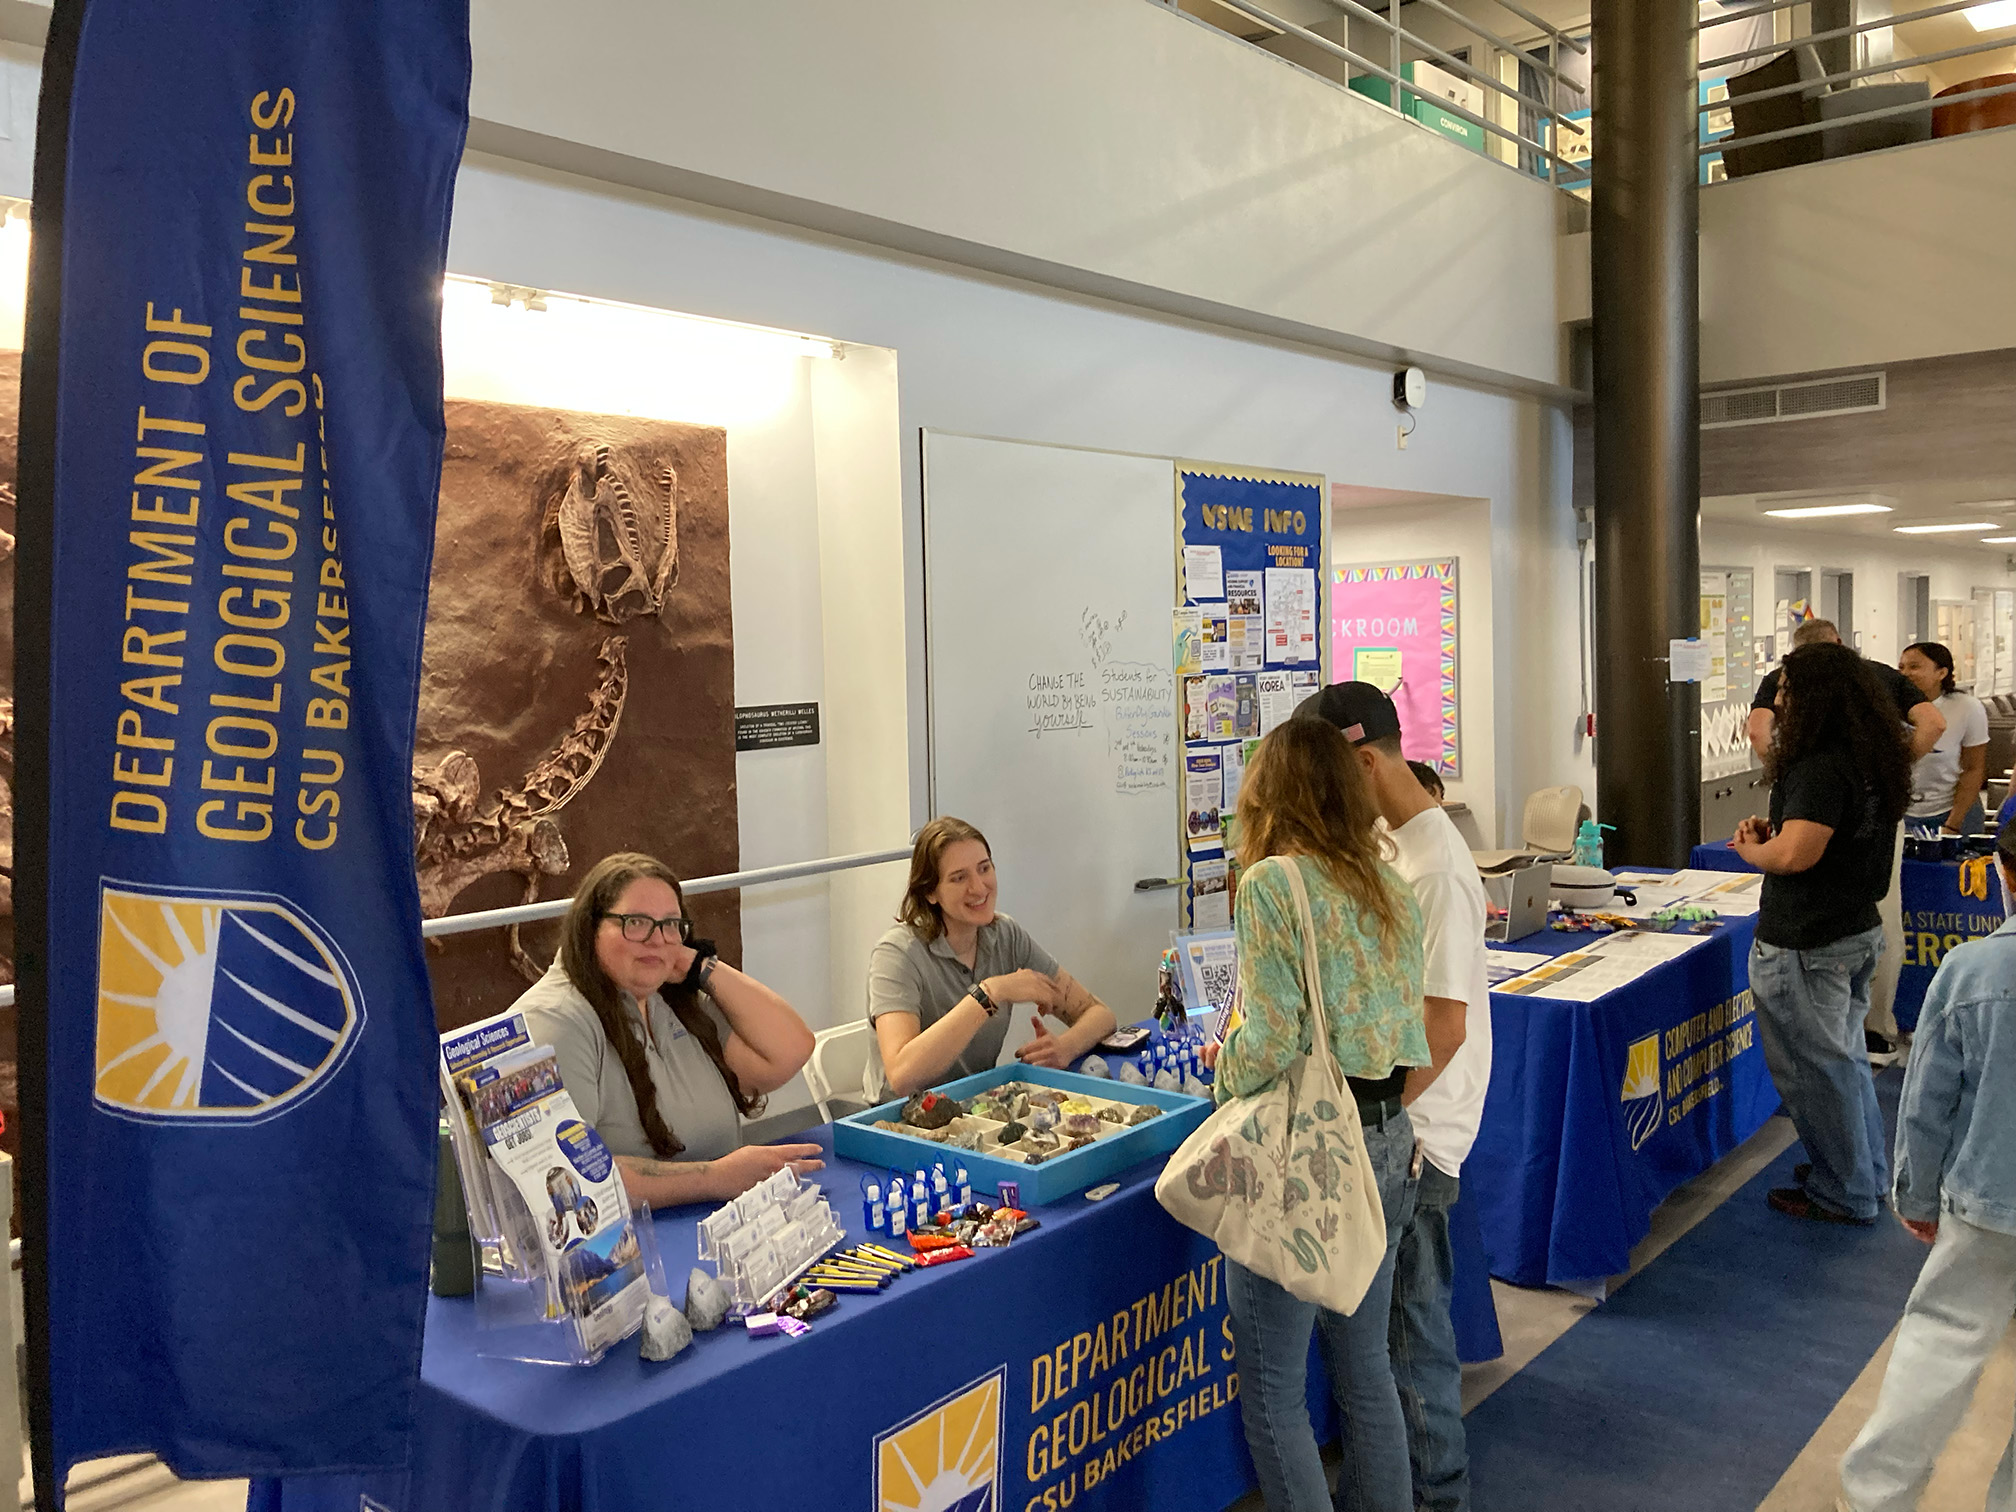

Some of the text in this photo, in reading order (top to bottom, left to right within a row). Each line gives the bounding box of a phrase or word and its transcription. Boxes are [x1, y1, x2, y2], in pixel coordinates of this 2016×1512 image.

[1440, 117, 1468, 137] CONVIRON
[196, 87, 307, 843] GEOLOGICAL SCIENCES
[1263, 507, 1307, 536] INFO
[1268, 545, 1309, 557] LOOKING FOR A
[1275, 556, 1304, 567] LOCATION?
[110, 301, 213, 835] DEPARTMENT OF
[1228, 589, 1257, 597] RESOURCES
[1029, 672, 1085, 691] CHANGE THE
[1102, 669, 1141, 685] Students
[1260, 680, 1285, 692] KOREA
[1027, 694, 1096, 711] WORLD BY BEING
[1102, 687, 1172, 702] SUSTAINABILITY
[798, 707, 815, 715] WELLES
[1034, 709, 1087, 739] yourself
[294, 748, 345, 850] CSU
[1916, 911, 1964, 931] STATE
[1216, 991, 1234, 1036] Geological
[445, 1026, 509, 1060] Geological Sciences
[1665, 1012, 1706, 1060] COMPUTER
[1708, 1003, 1724, 1036] AND
[1667, 1020, 1753, 1101] AND COMPUTER SCIENCE
[492, 1107, 541, 1141] GEOSCIENTISTS
[505, 1129, 533, 1150] GET JOBS!
[1031, 1253, 1223, 1415] DEPARTMENT
[1027, 1328, 1211, 1482] GEOLOGICAL
[1083, 1373, 1240, 1491] BAKERSFIELD
